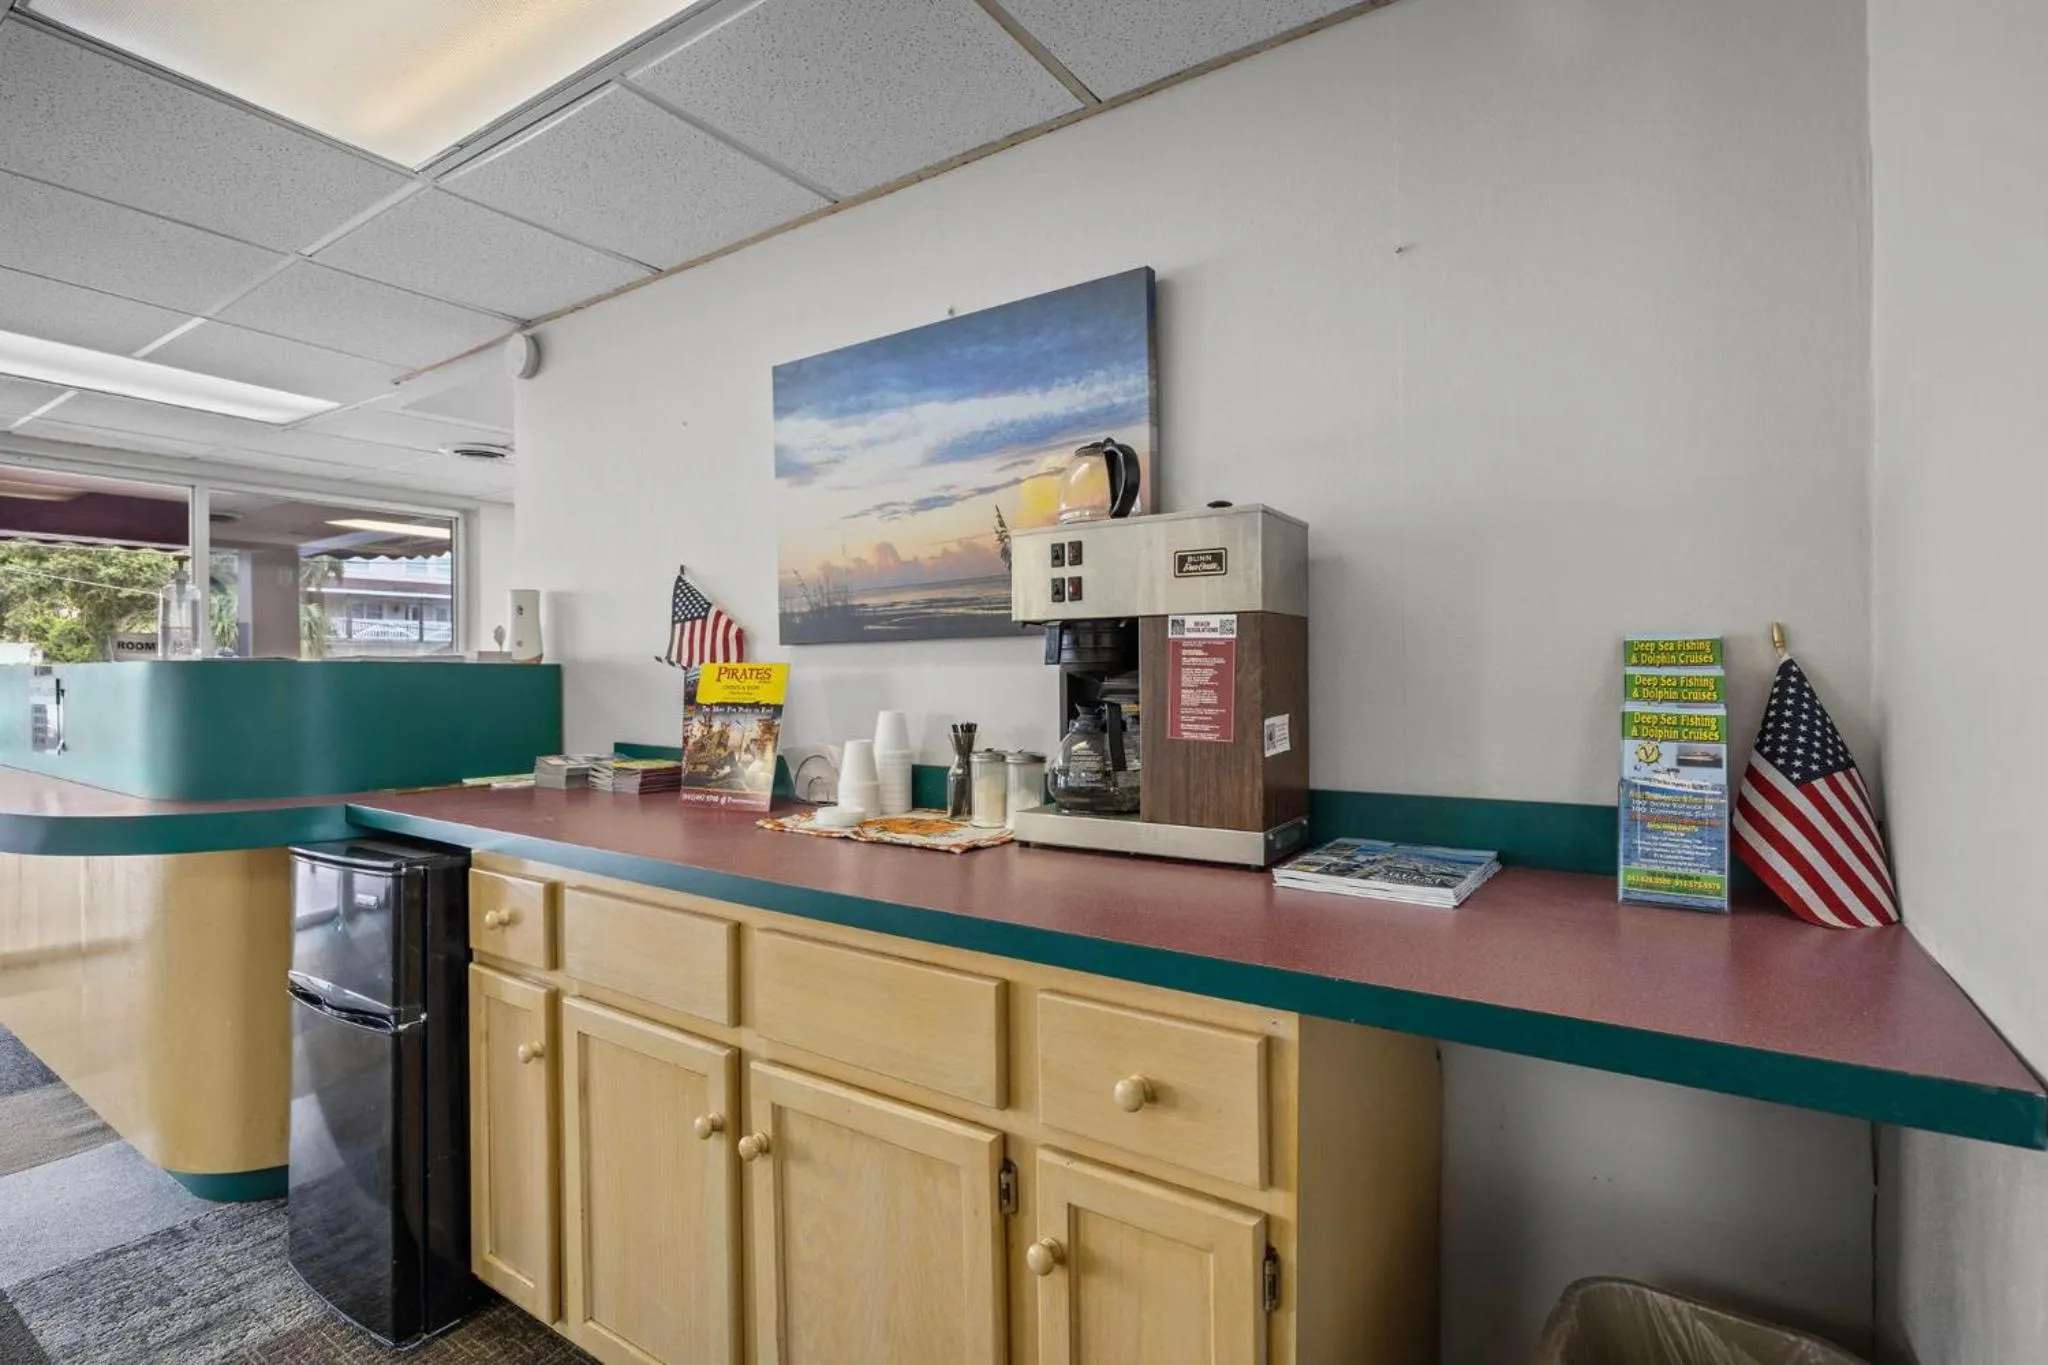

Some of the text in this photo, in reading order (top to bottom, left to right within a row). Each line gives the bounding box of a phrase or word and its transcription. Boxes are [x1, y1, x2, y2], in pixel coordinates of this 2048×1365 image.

[1186, 554, 1212, 562] BUNN
[1633, 640, 1711, 653] Deep Sea Fishing
[1631, 653, 1714, 666] & Dolphin Cruises
[716, 666, 772, 683] PIRATES
[1635, 675, 1714, 691] Deep Sea Fishing
[1632, 688, 1717, 701] & Dolphin Cruises
[1633, 712, 1716, 730] Deep Sea Fishing
[1631, 727, 1720, 741] & Dolphin Cruises
